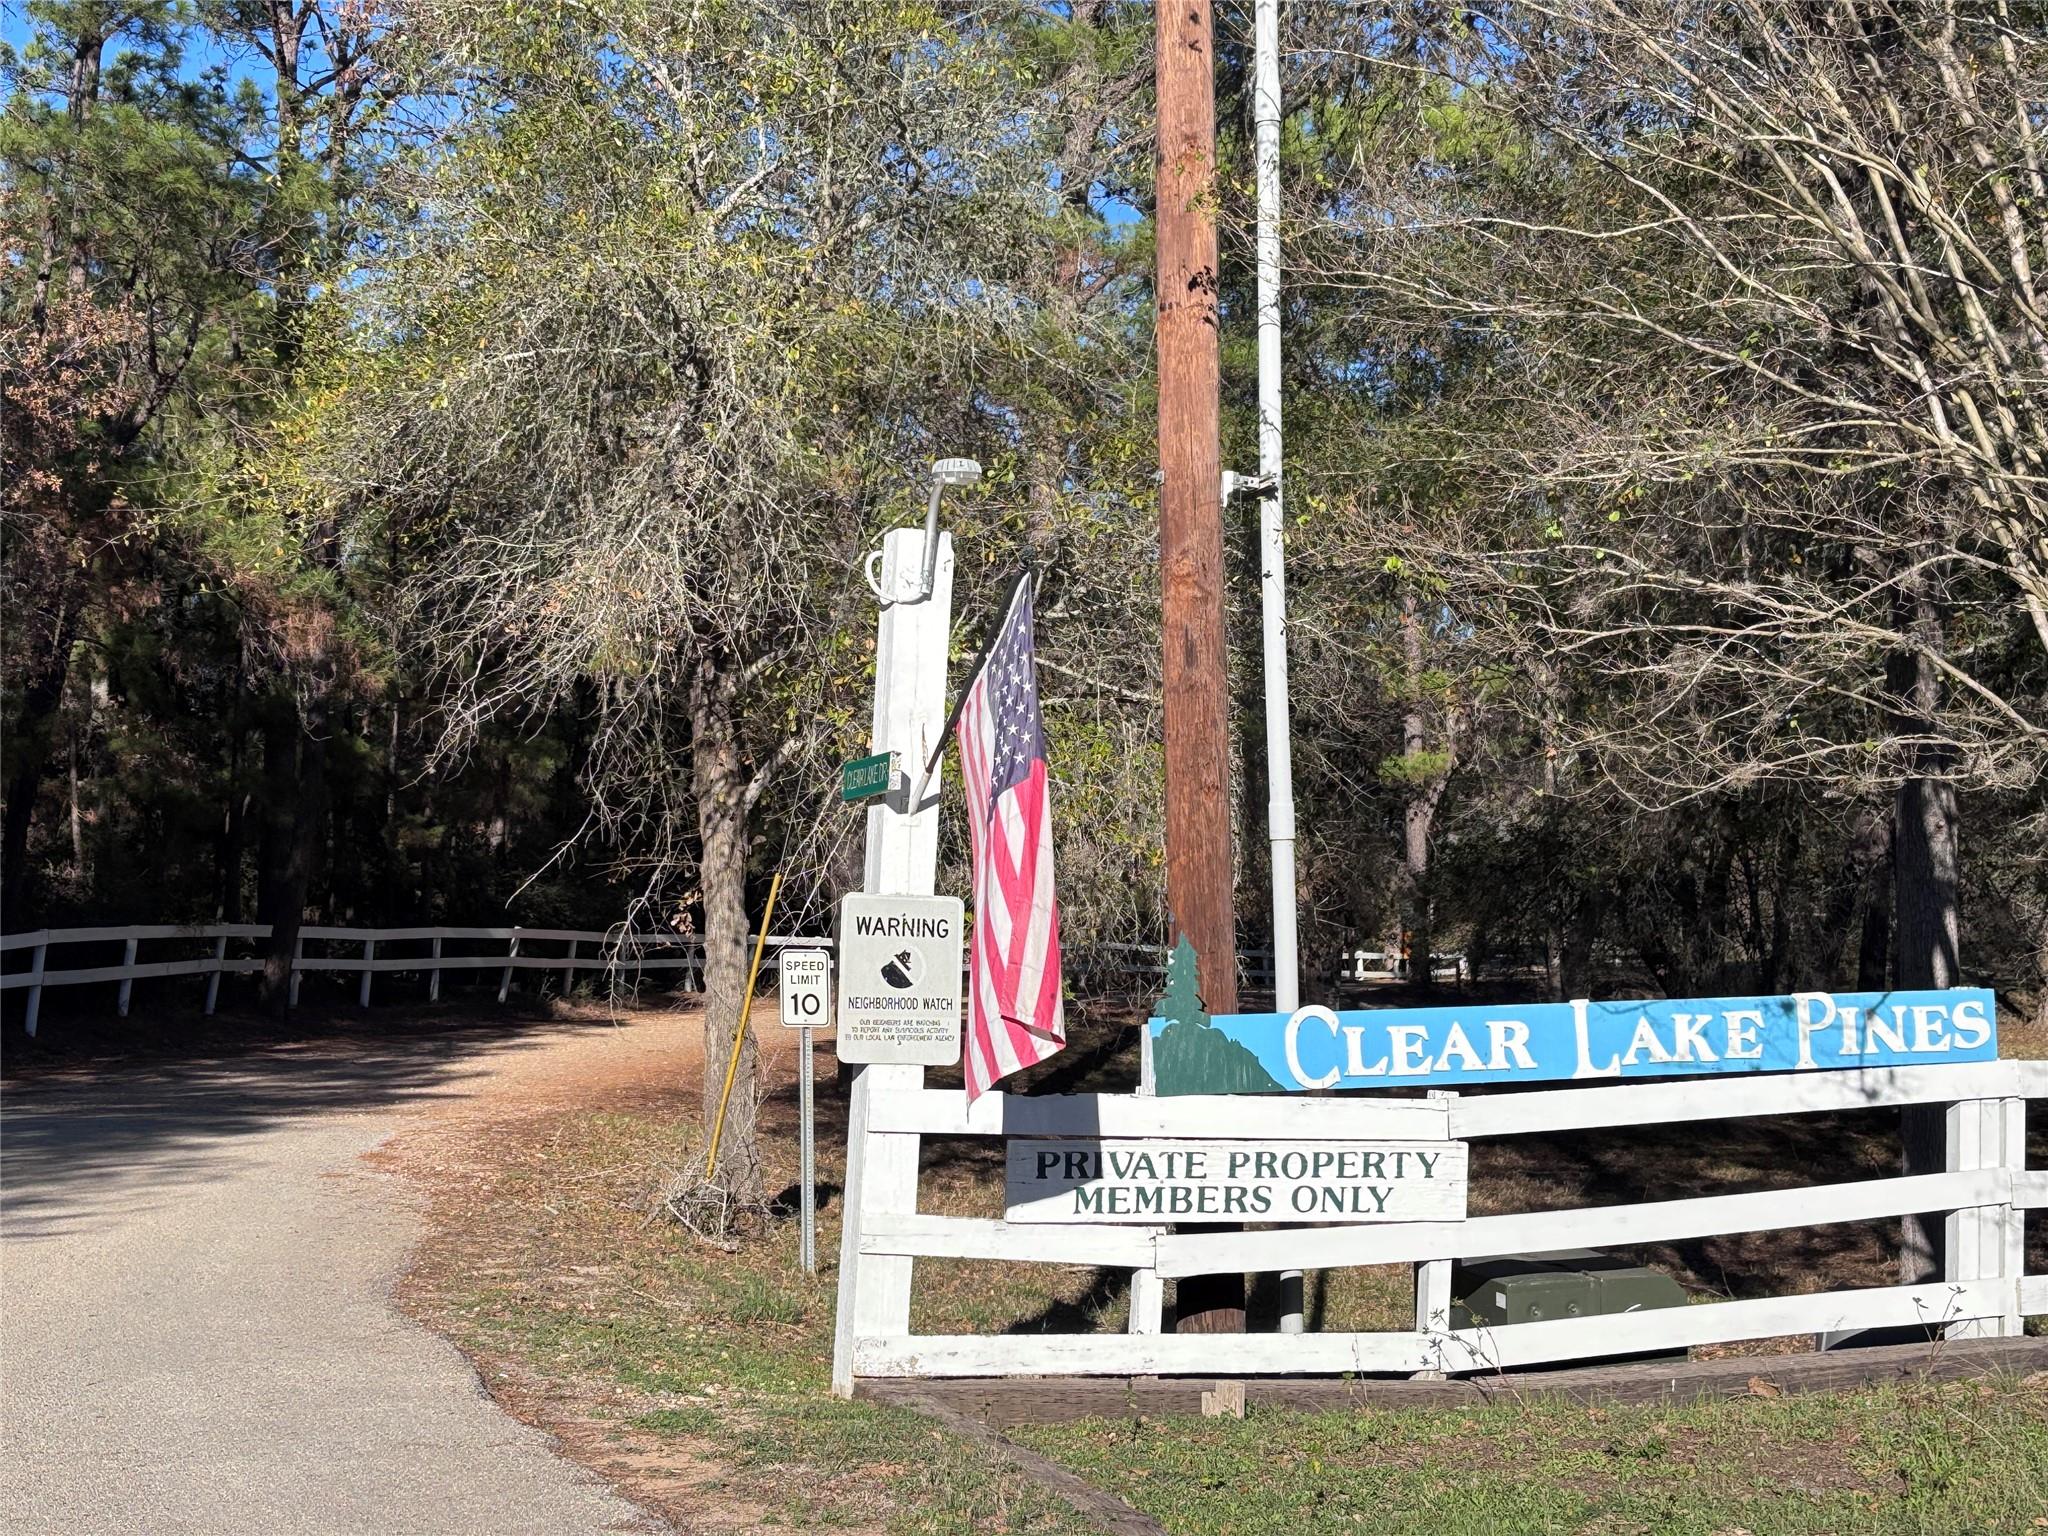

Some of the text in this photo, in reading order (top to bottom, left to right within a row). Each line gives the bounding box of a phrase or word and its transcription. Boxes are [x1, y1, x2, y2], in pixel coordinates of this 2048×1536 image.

[856, 916, 949, 938] WARNING
[786, 961, 824, 970] SPEED
[790, 975, 821, 985] LIMIT
[791, 993, 820, 1015] 10
[848, 997, 953, 1011] NEIGHBORHOOD WATCH
[1285, 992, 1992, 1090] CLEAR LAKE PINES
[1036, 1151, 1440, 1180] PRIVATE PROPERTY
[1073, 1186, 1394, 1214] MEMBERS ONLY
